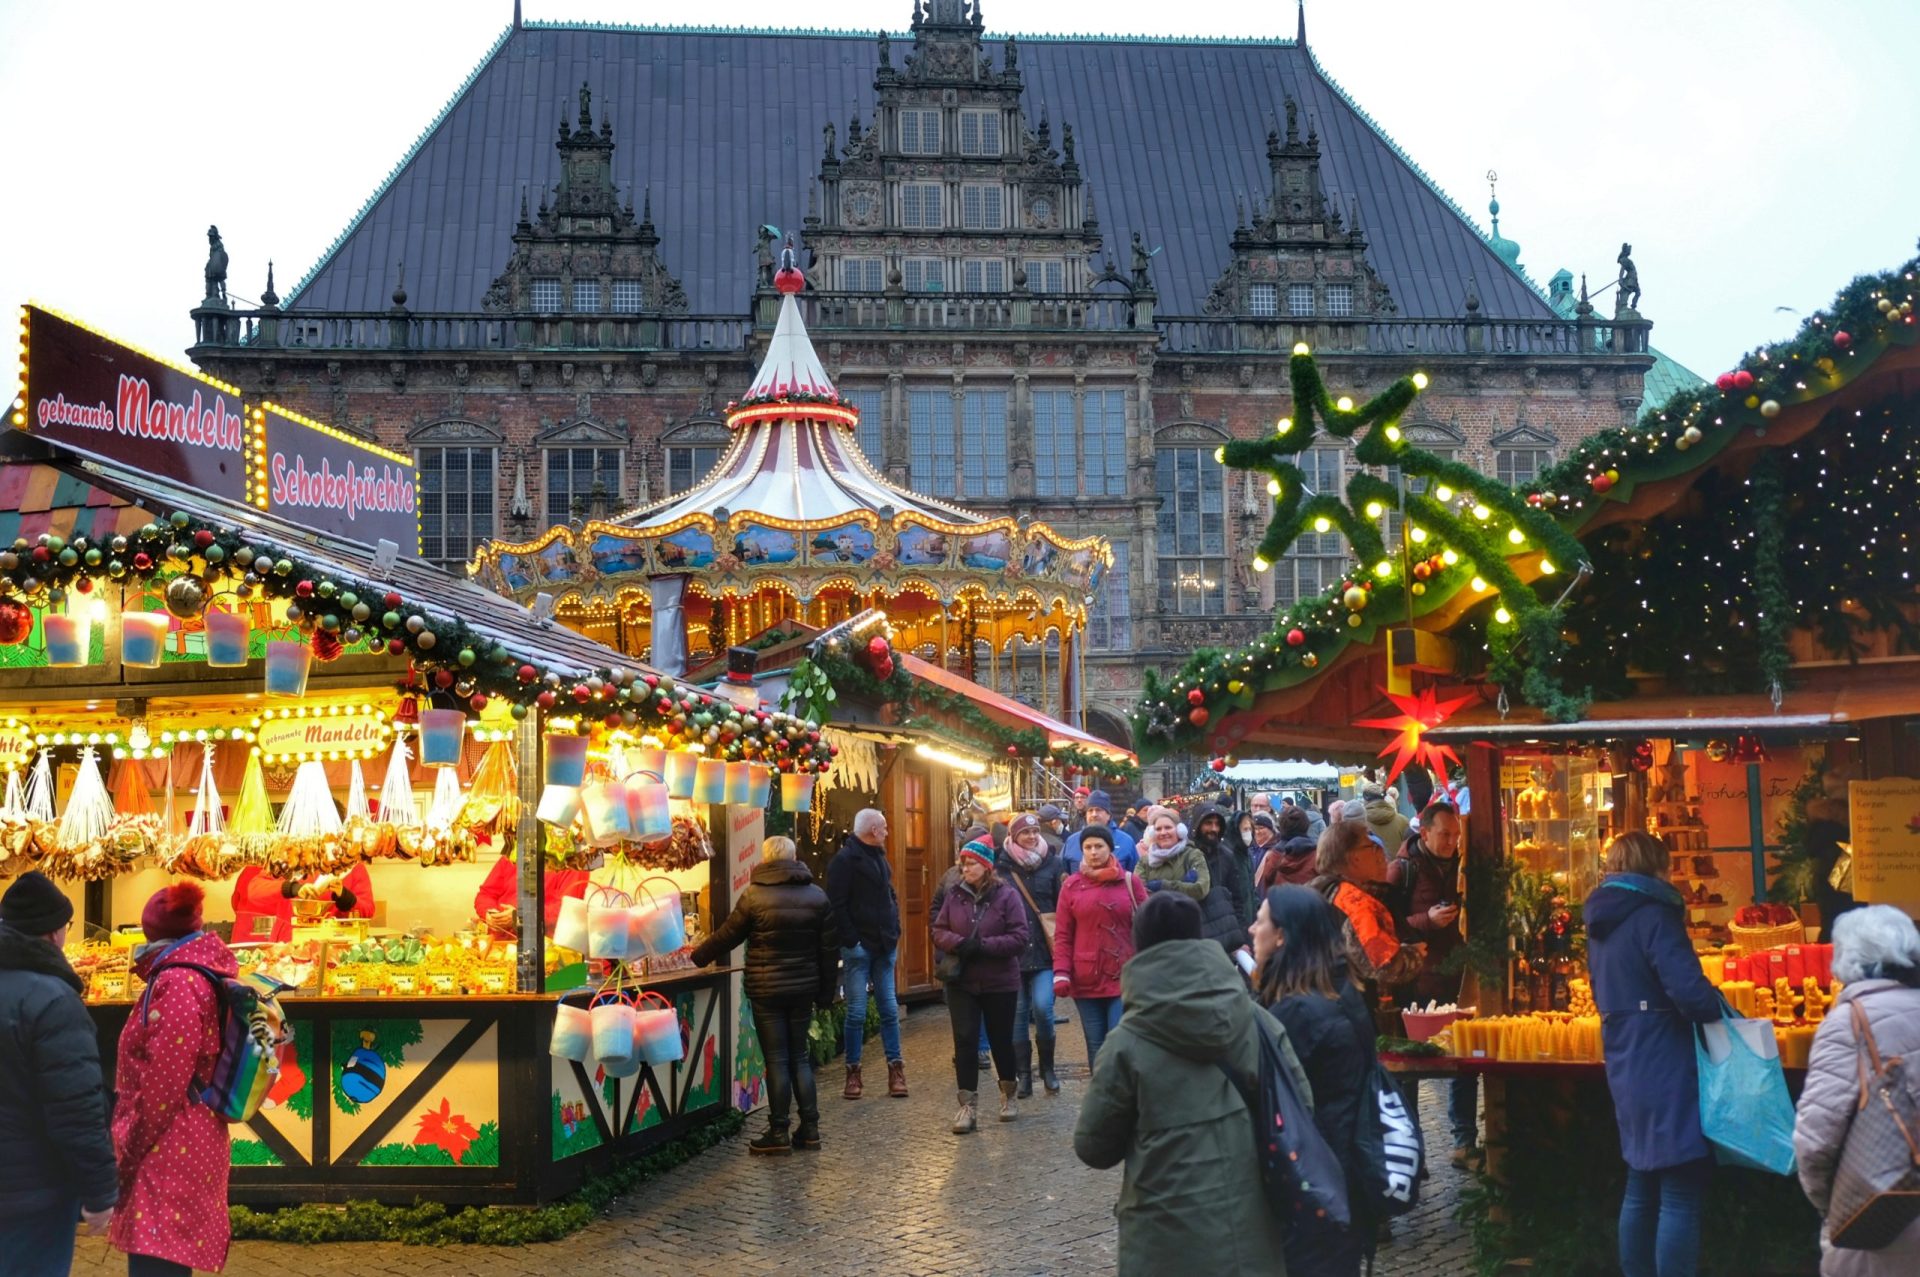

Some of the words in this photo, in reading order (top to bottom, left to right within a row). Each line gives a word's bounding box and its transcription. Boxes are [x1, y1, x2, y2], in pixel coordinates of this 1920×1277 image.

[37, 392, 114, 431] gebrannte
[116, 373, 242, 452] Mandeln
[272, 451, 414, 521] Schokofrüchte
[265, 728, 302, 746] gebrannte
[304, 723, 380, 743] Mandeln
[1377, 1089, 1419, 1203] PUMA
